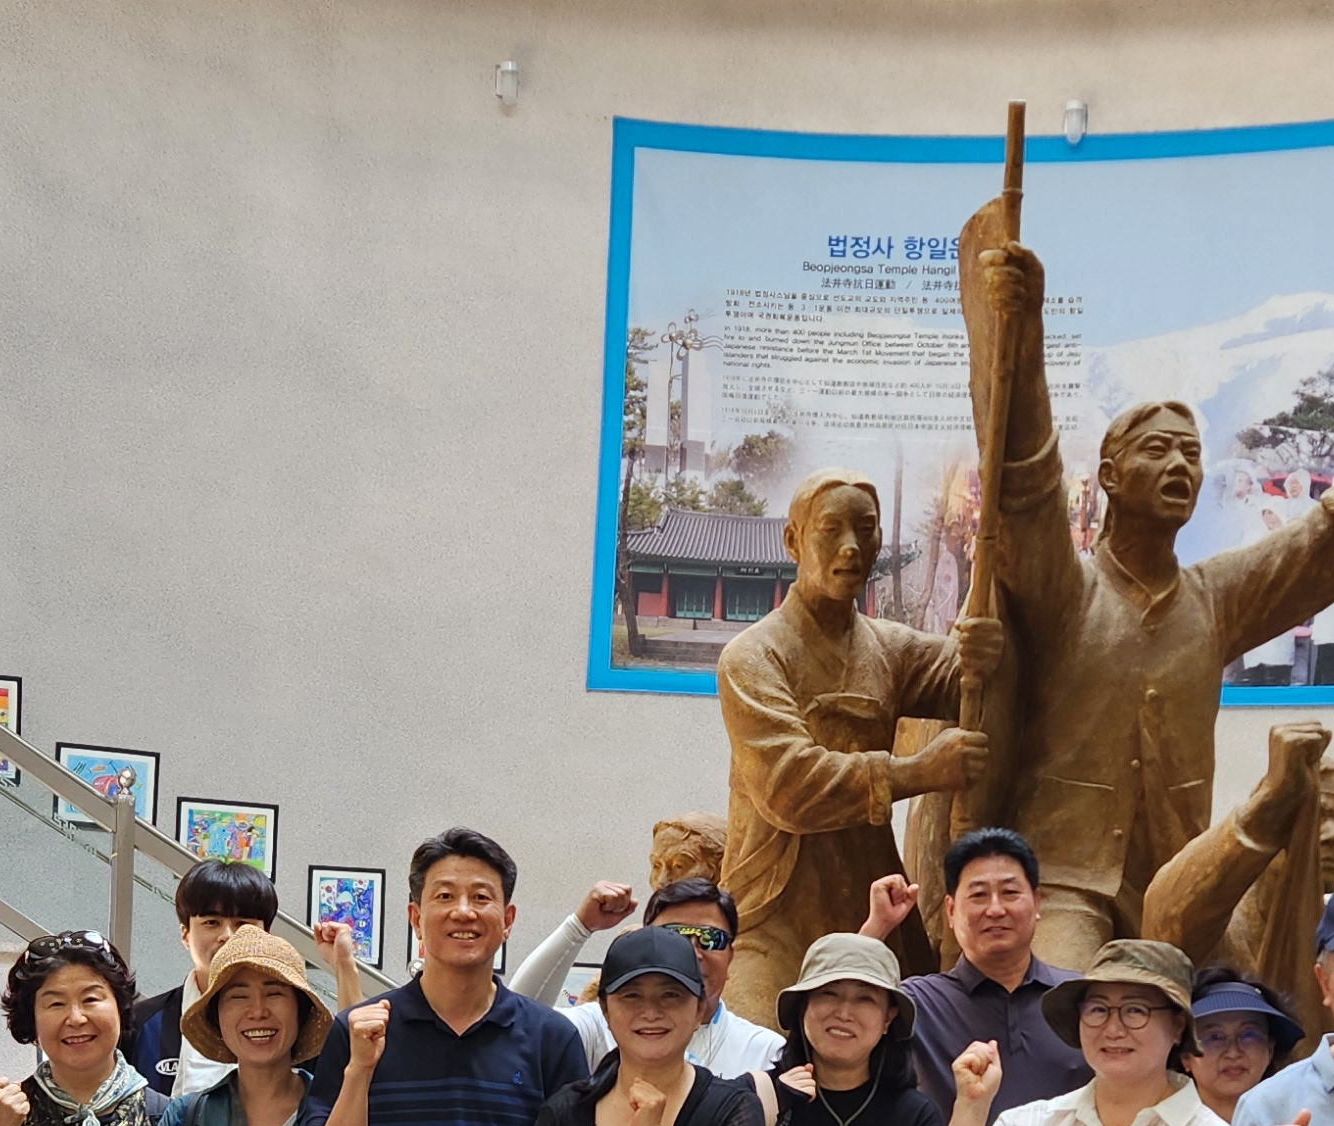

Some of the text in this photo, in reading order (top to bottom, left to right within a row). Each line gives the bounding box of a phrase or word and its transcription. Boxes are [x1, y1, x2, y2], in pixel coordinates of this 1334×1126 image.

[828, 235, 894, 259] 법정사
[802, 261, 957, 277] Beopjeongsa Temple Hangil
